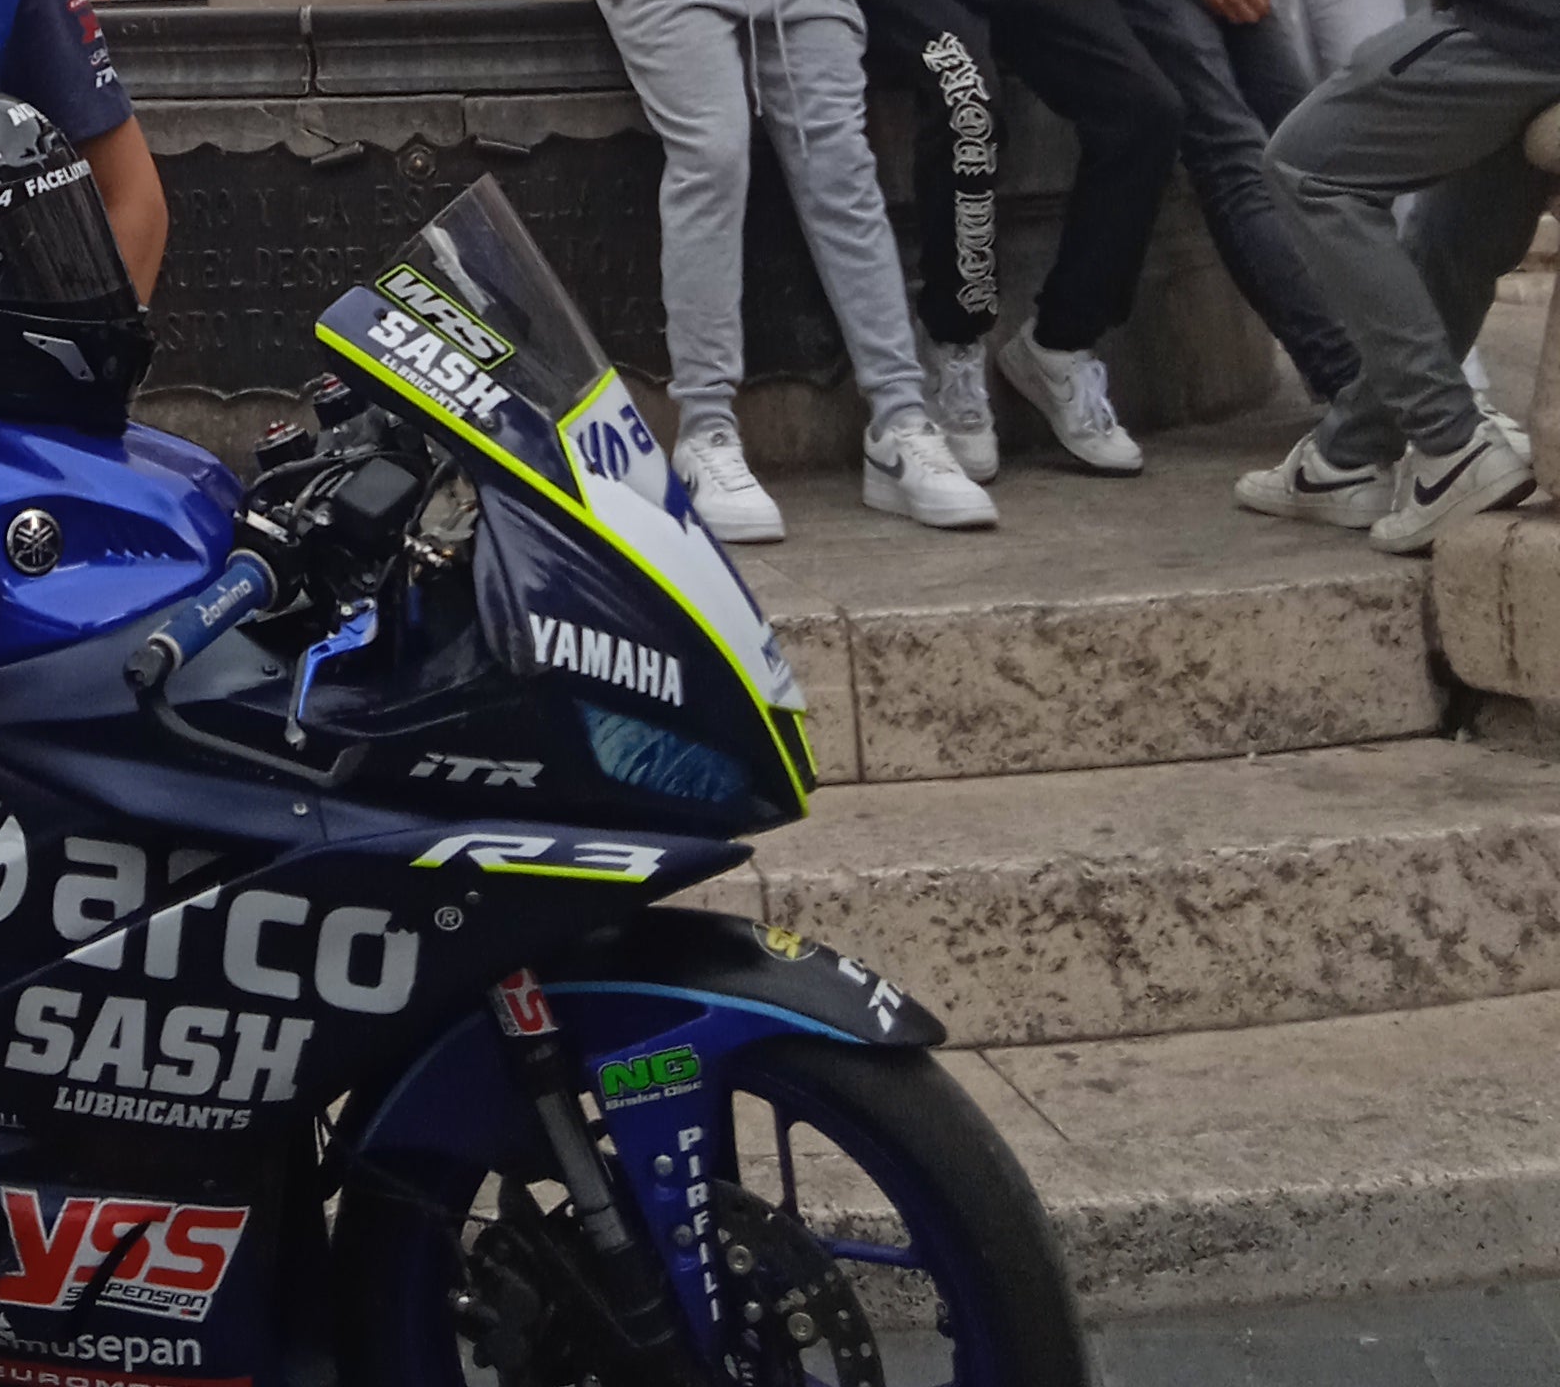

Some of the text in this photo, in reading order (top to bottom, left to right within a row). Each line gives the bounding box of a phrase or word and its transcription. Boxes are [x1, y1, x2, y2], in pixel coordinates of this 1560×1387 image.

[383, 269, 509, 360] WRS
[367, 310, 512, 419] SASH
[195, 577, 254, 628] domino
[529, 614, 684, 708] YAMAHA
[409, 833, 667, 884] R3
[51, 835, 419, 1015] arco
[4, 984, 314, 1104] SASH
[598, 1043, 702, 1100] NG
[53, 1085, 251, 1130] LUBRICANTS
[64, 1281, 207, 1311] SPENSION
[13, 1332, 203, 1374] musepan
